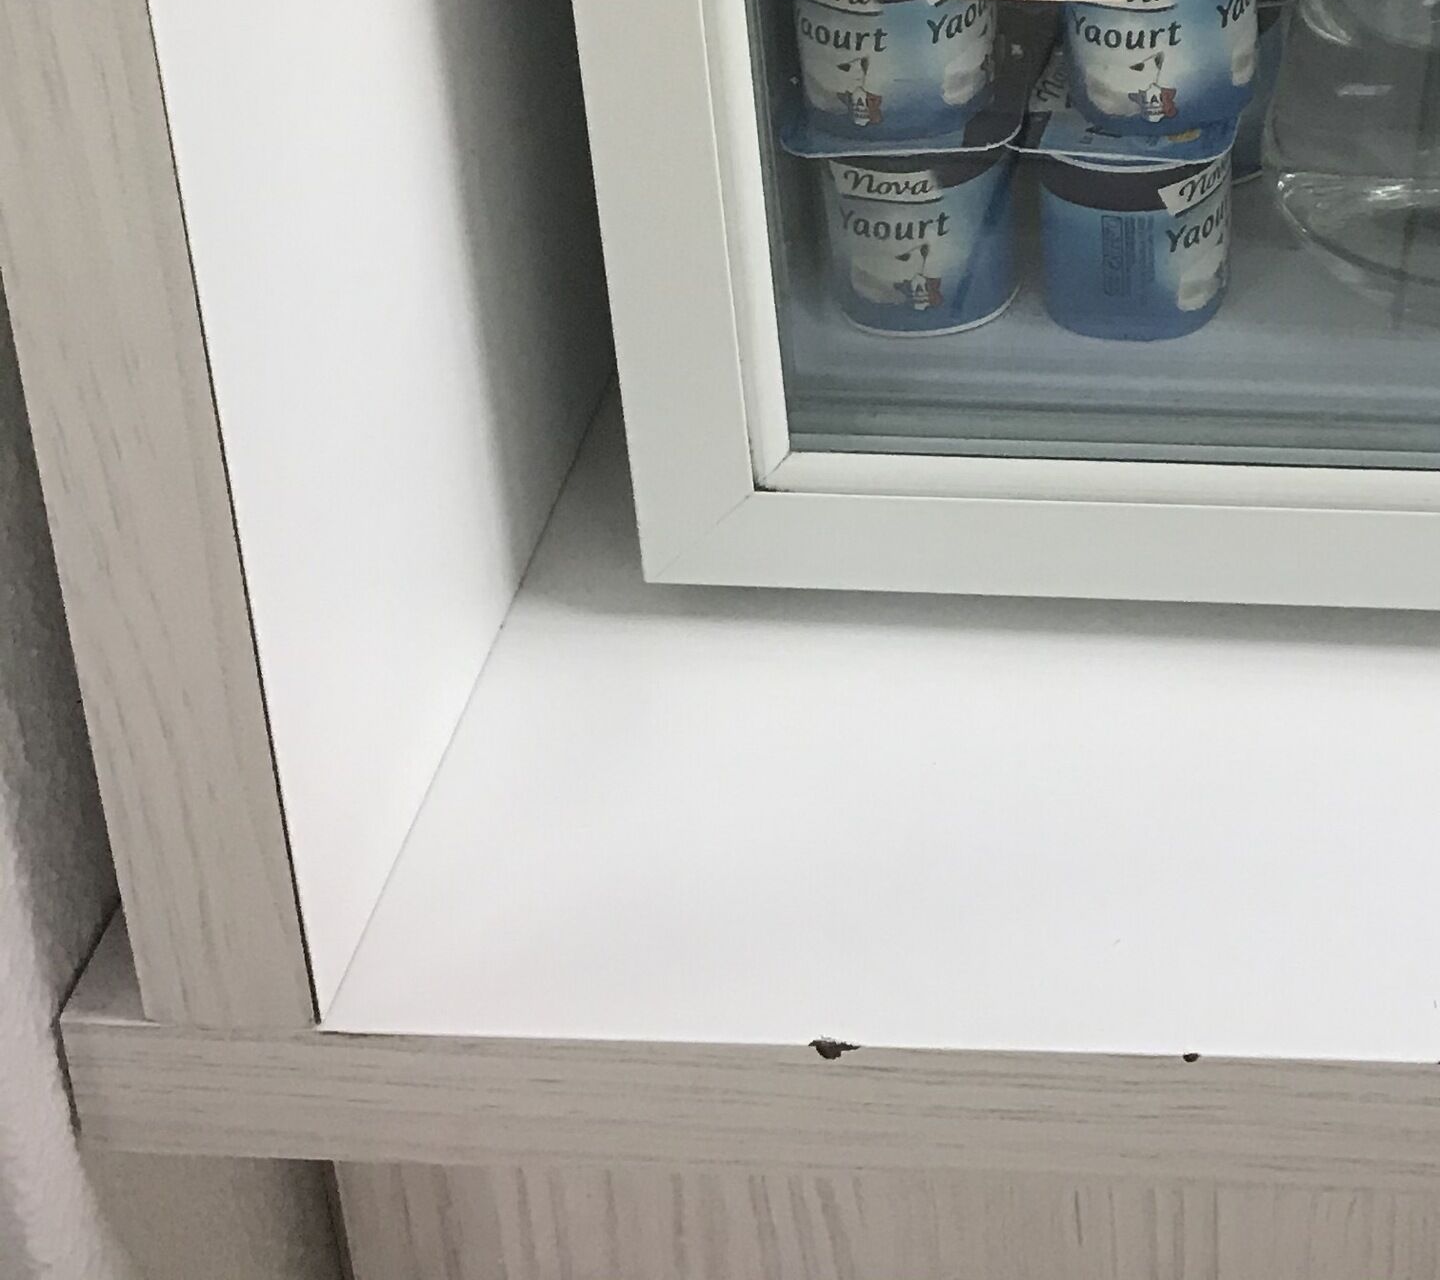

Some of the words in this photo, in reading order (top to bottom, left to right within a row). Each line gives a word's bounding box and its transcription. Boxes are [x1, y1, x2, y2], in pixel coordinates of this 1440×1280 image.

[801, 16, 888, 53] aourt
[1072, 8, 1182, 50] Yaourt
[843, 169, 934, 196] Nova
[839, 207, 951, 240] Yaourt
